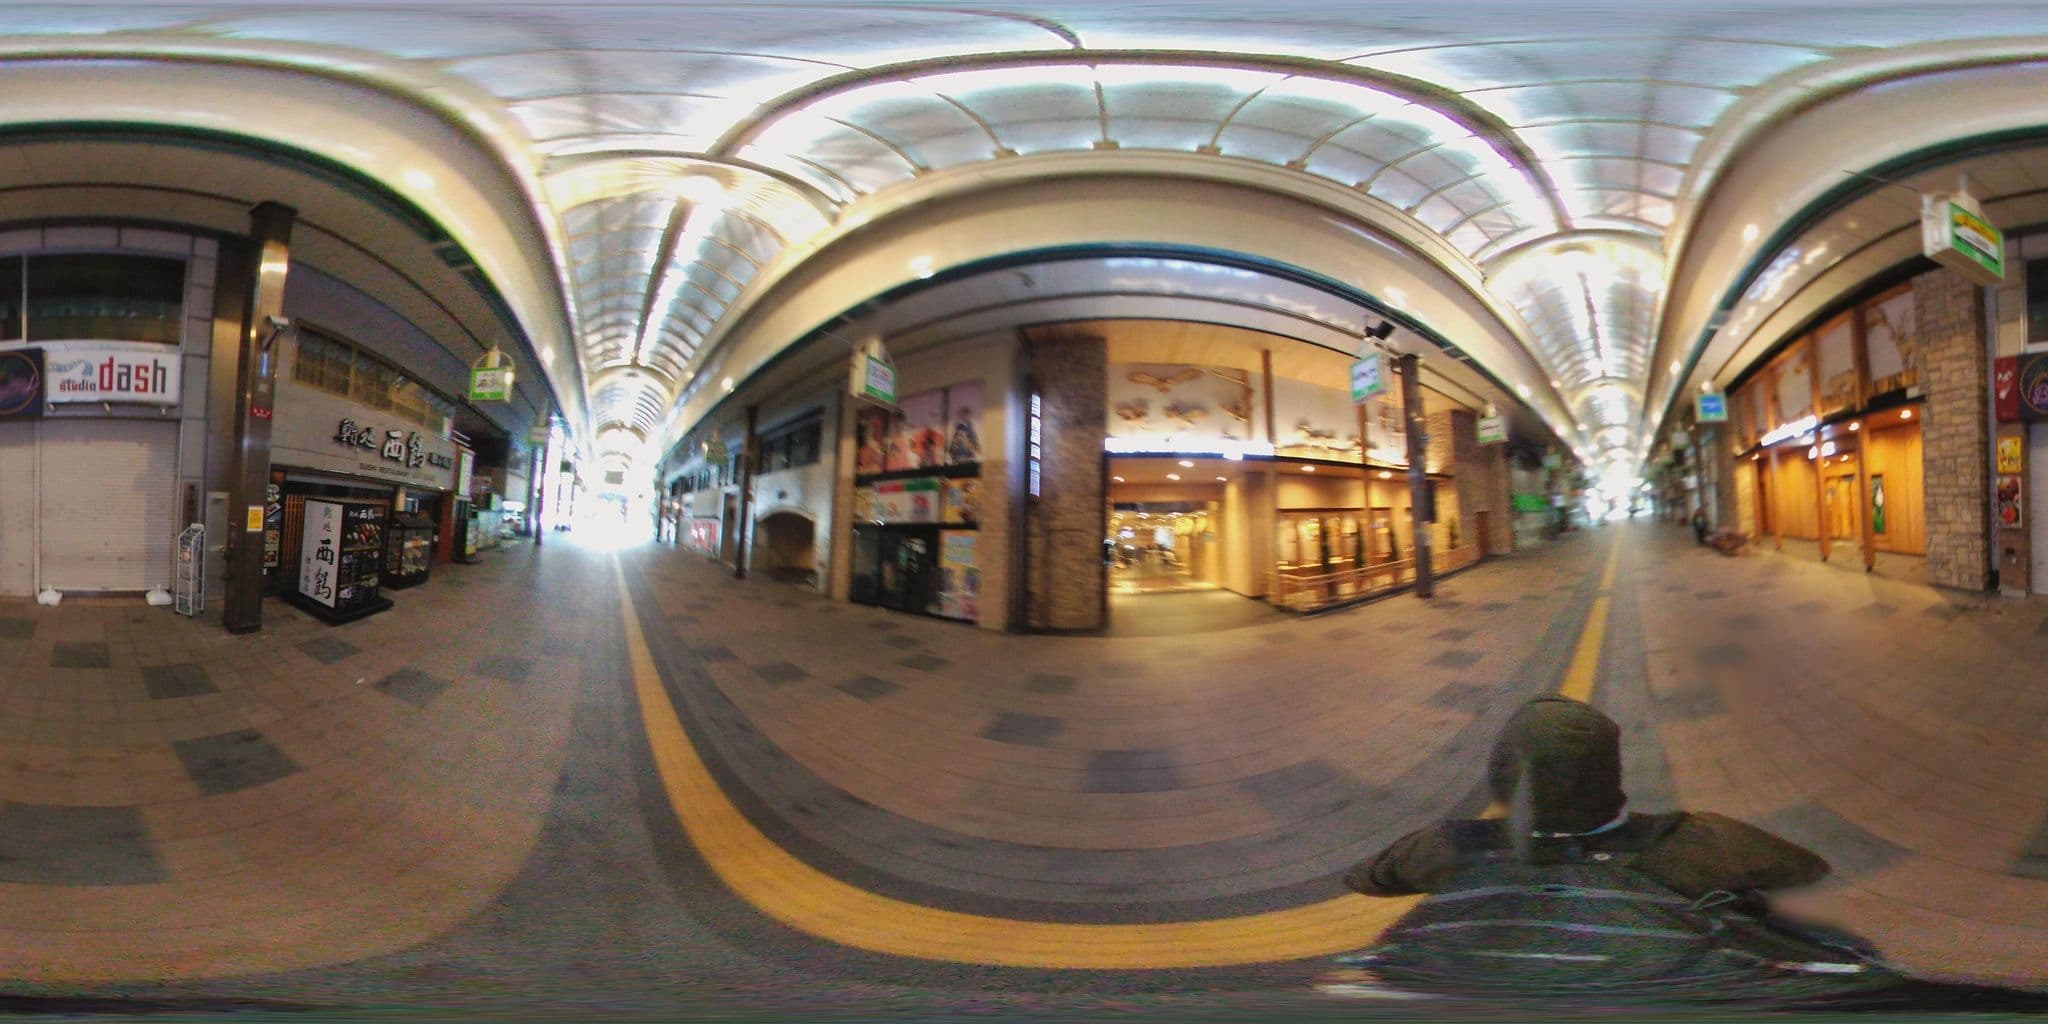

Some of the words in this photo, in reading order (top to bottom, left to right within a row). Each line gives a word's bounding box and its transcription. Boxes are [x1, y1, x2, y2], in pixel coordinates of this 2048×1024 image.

[60, 379, 96, 392] studio
[99, 356, 166, 394] dash
[315, 538, 335, 599] 西鶴
